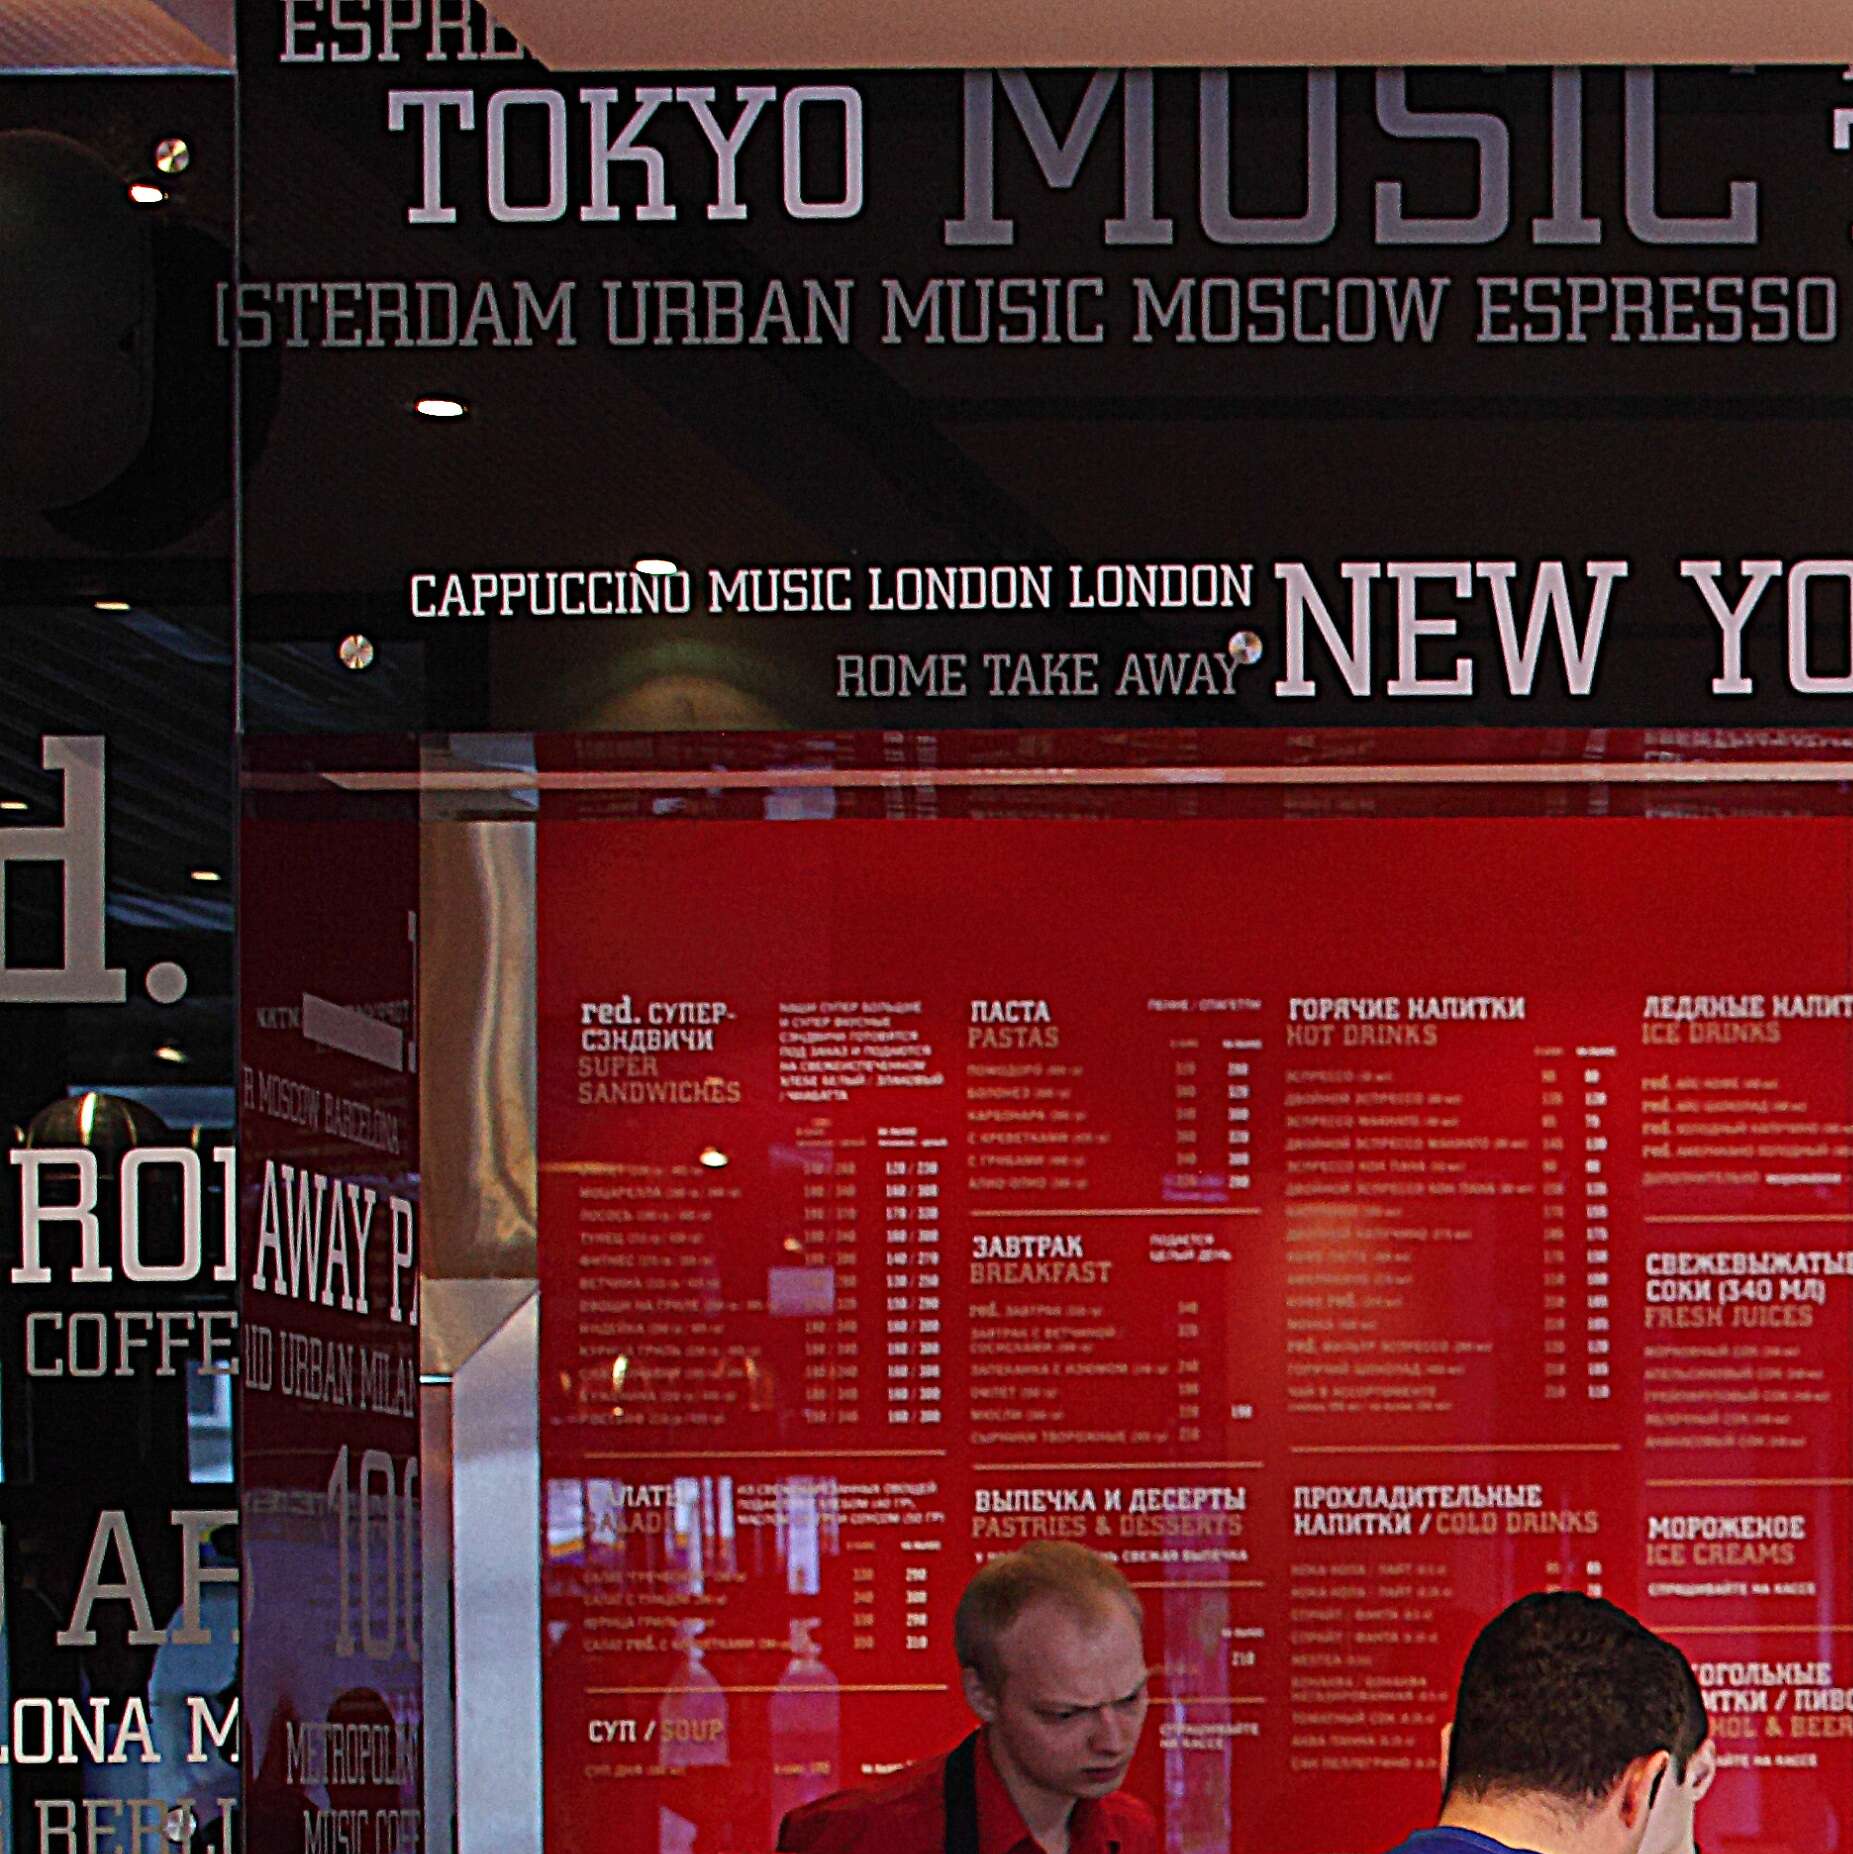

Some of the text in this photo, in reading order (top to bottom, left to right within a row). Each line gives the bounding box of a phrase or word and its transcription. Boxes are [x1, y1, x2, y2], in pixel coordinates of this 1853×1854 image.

[280, 0, 537, 62] ESPRE
[388, 86, 863, 223] TOKYO
[944, 68, 1757, 245] MUSIC
[604, 279, 853, 346] URBAN
[883, 278, 1104, 345] MUSIC
[1134, 276, 1451, 345] MOSCOW
[1477, 276, 1836, 343] ESPRESSO
[410, 564, 1253, 617] CAPPUCCINO MUSIC LONDON LONDON
[1275, 560, 1628, 697] NEW
[836, 651, 1242, 697] ROME TAKE AWAY
[580, 995, 736, 1025] red. СУПЕР-
[970, 1000, 1051, 1024] ПАСТА
[1289, 997, 1400, 1021] ГОРЯЧИЕ
[1408, 996, 1526, 1020] НАПИТКИ
[1644, 995, 1765, 1020] ЛЕДЯНЫЕ
[581, 1028, 713, 1053] СЭНДВИЧИ
[968, 1026, 1059, 1049] PASTAS
[1287, 1024, 1437, 1047] HOT DRINKS
[1642, 1020, 1781, 1045] ICE DRINKS
[578, 1056, 658, 1077] SUPER
[579, 1081, 740, 1104] SANDWICHES
[253, 1159, 376, 1314] AWAY
[972, 1235, 1083, 1259] ЗАВТРАК
[970, 1261, 1112, 1284] BREAKFAST
[1646, 1280, 1711, 1302] СОКИ
[1644, 1304, 1813, 1328] FRESH JUICES
[281, 1331, 353, 1406] URBAN
[975, 1487, 1246, 1513] ВЫПЕЧКА И ДЕСЕРТЫ
[1294, 1484, 1542, 1510] ПРОХЛАДИТЕЛЬНЫЕ
[972, 1514, 1243, 1538] PASTRIES & DESSERTS
[1294, 1511, 1598, 1536] НАПИТКИ COLD DRINKS
[1649, 1516, 1806, 1540] МОРОЖЕНОЕ
[1646, 1543, 1795, 1566] ICE CREAMS
[1692, 1663, 1833, 1686] ОГОЛЬНЫЕ
[0, 1697, 160, 1763] ONA
[588, 1718, 725, 1743] СУП SOUP
[1792, 1715, 1853, 1737] BEER
